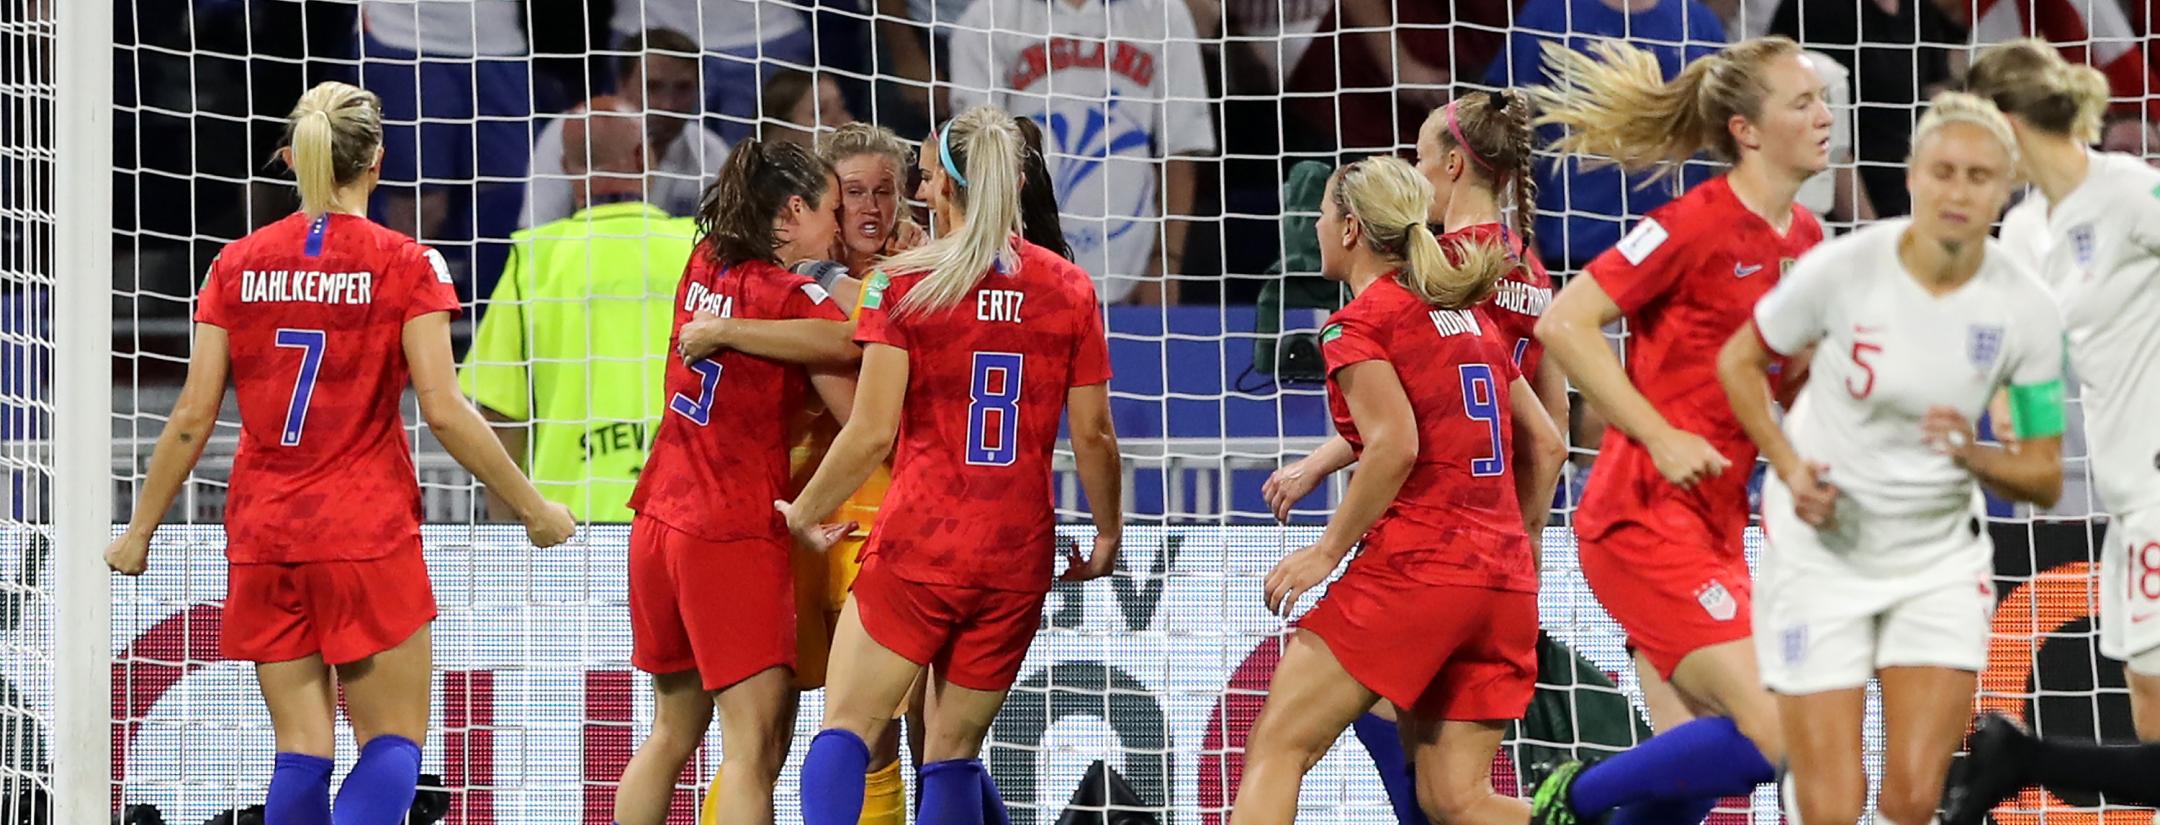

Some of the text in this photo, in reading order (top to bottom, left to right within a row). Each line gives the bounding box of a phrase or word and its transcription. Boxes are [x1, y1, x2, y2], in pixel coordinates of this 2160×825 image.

[241, 270, 371, 304] DAHLKEMPER
[977, 289, 1024, 323] ERTZ
[275, 328, 326, 446] 7
[1845, 342, 1882, 400] 5
[964, 351, 1023, 466] 8
[1458, 363, 1504, 477] 9
[2127, 541, 2160, 600] 18
